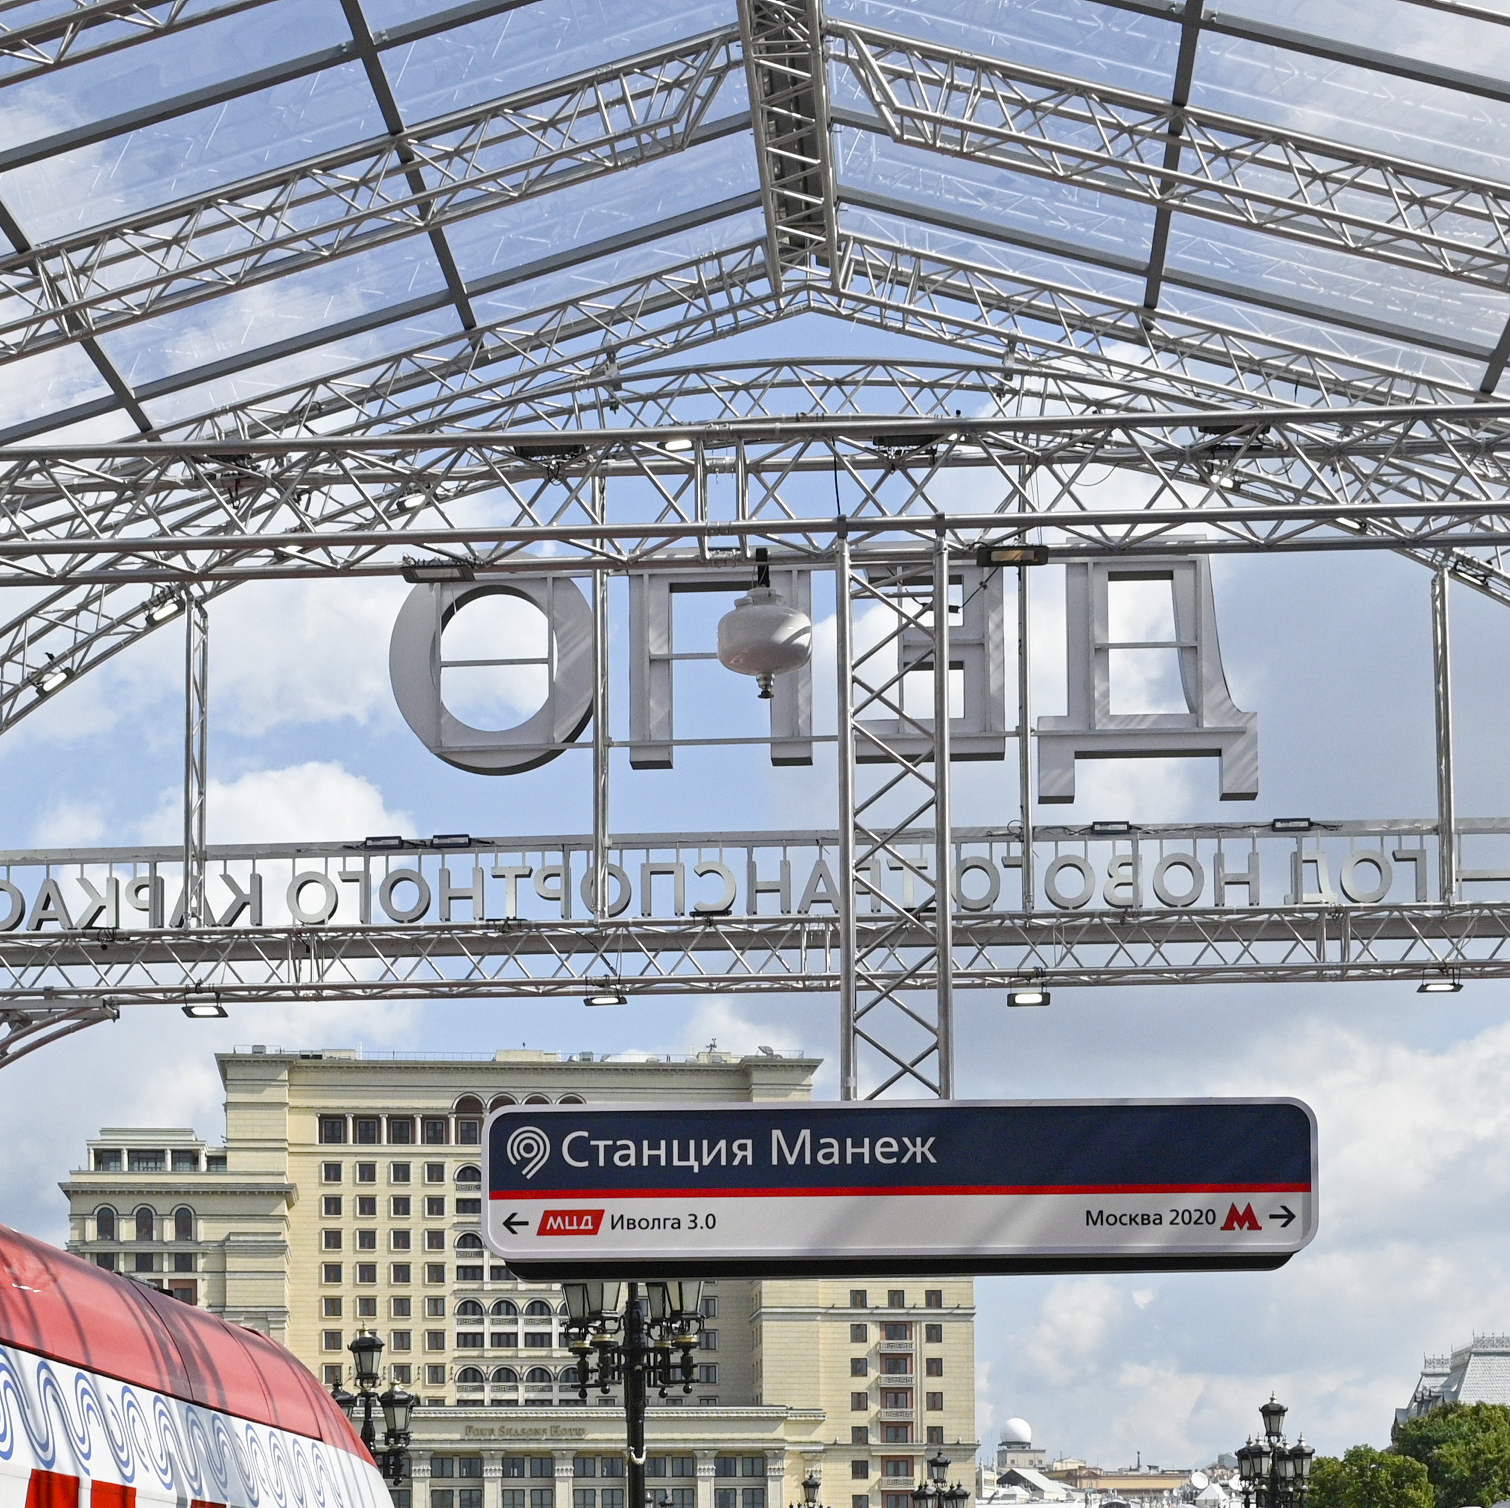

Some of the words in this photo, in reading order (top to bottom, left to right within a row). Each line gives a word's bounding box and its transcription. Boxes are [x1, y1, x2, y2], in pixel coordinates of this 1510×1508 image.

[561, 1131, 754, 1175] Станция
[771, 1128, 938, 1166] Манеж
[546, 1211, 597, 1236] МЦД
[610, 1211, 681, 1235] Иволга
[688, 1211, 717, 1232] 3.0
[1086, 1207, 1163, 1228] Москва
[1169, 1206, 1217, 1228] 2020
